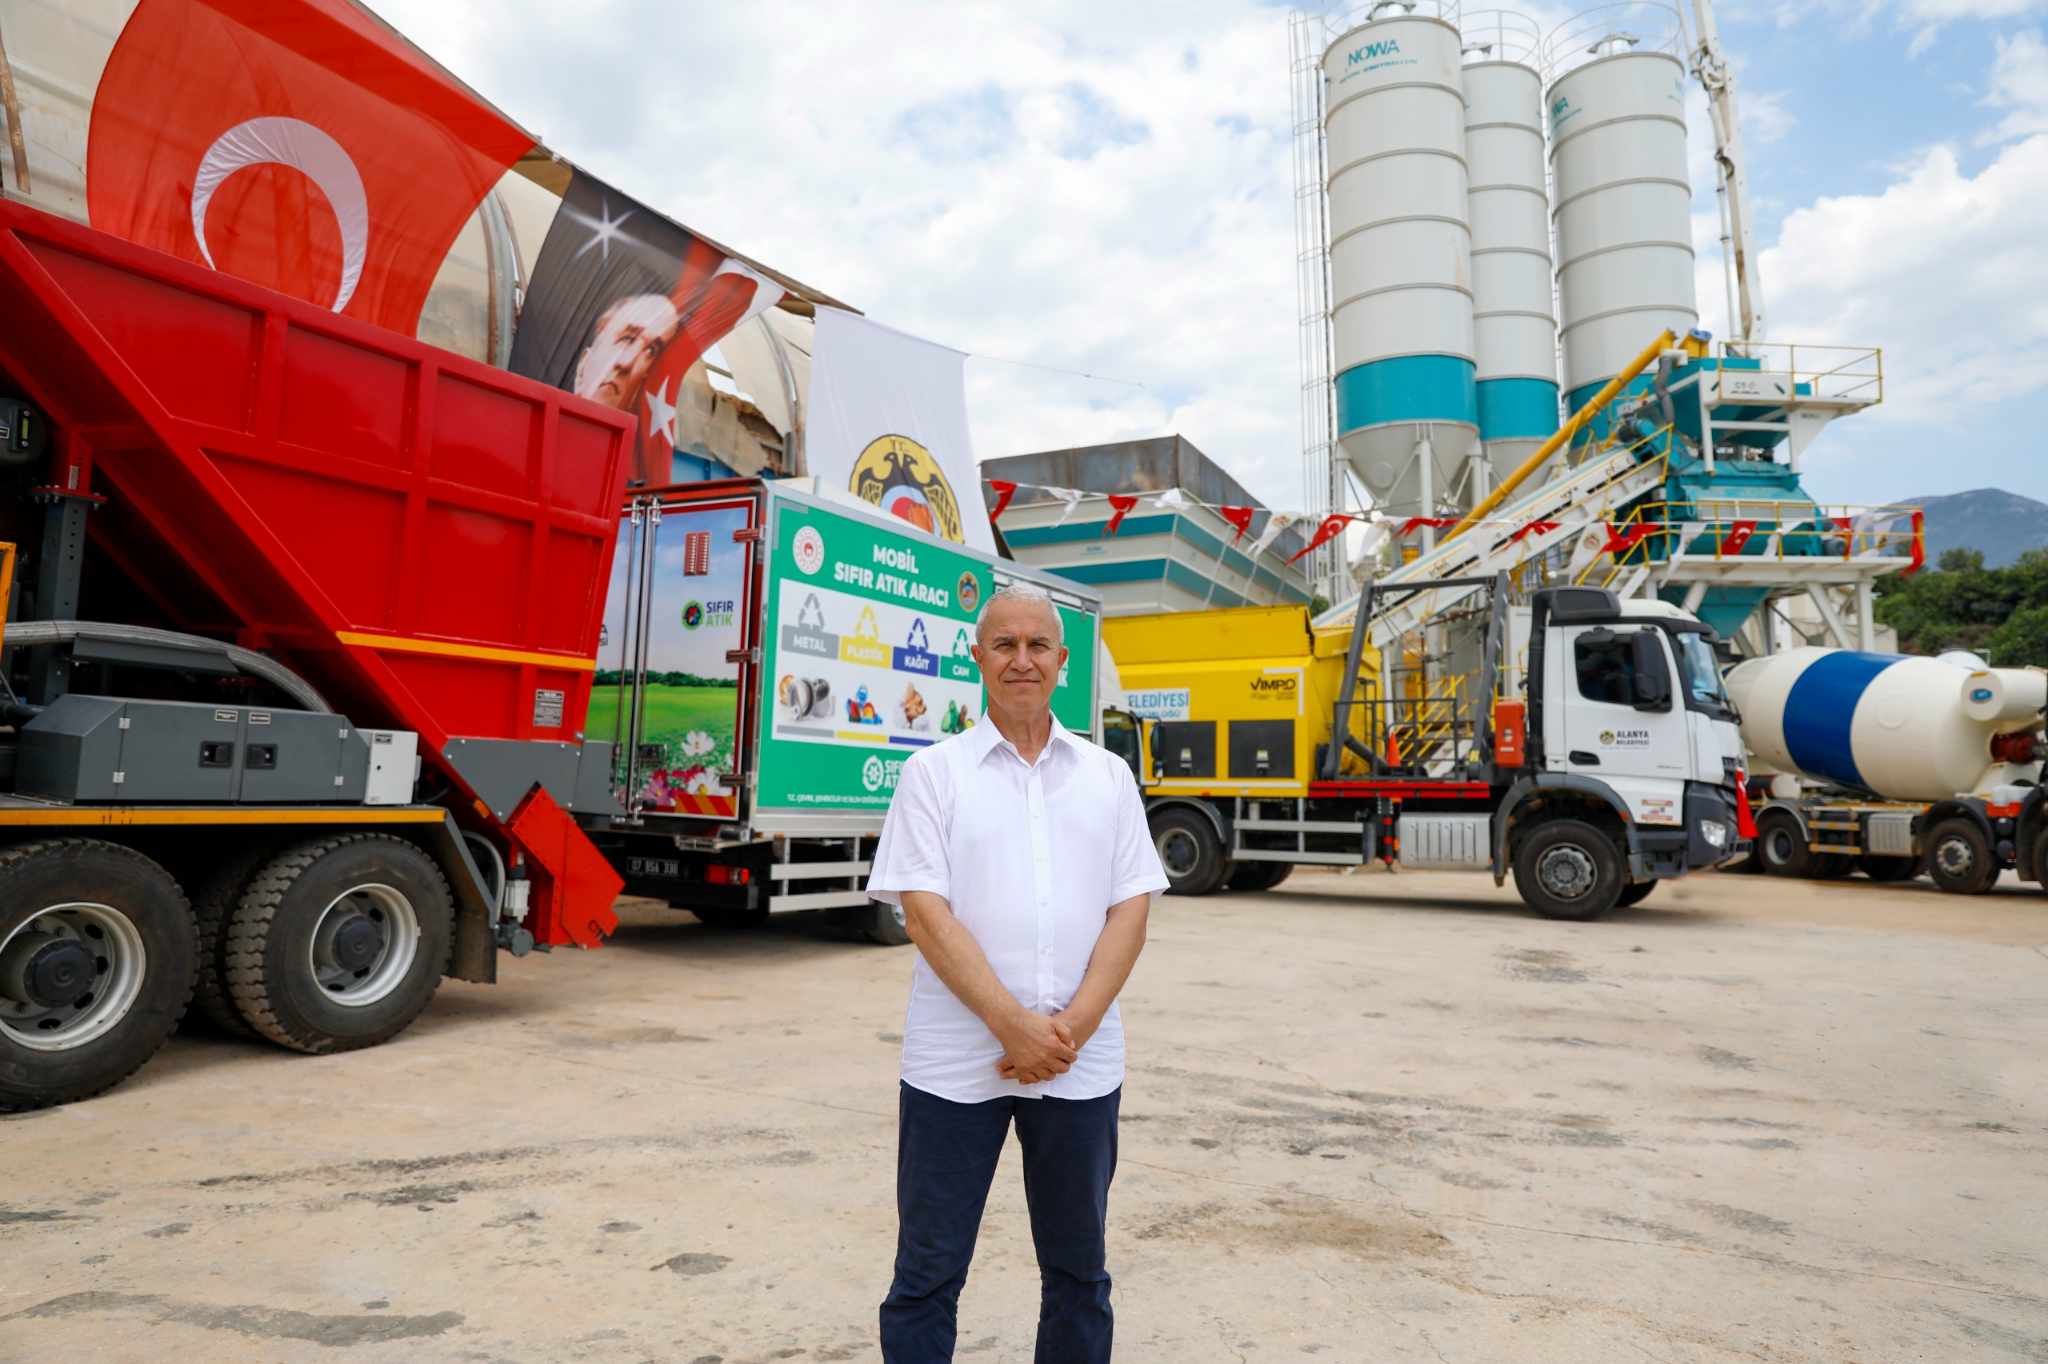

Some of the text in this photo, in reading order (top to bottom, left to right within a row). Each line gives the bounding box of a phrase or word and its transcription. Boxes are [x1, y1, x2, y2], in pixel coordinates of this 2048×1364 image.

[1347, 39, 1400, 67] NOWA
[872, 543, 920, 575] MOBİL
[833, 560, 950, 609] SIFIR ATIK ARACI
[706, 600, 734, 614] SIFIR
[705, 614, 733, 627] ATIK
[792, 634, 827, 653] METAL
[904, 653, 931, 671] KAĞIT
[1616, 730, 1649, 738] ALANYA
